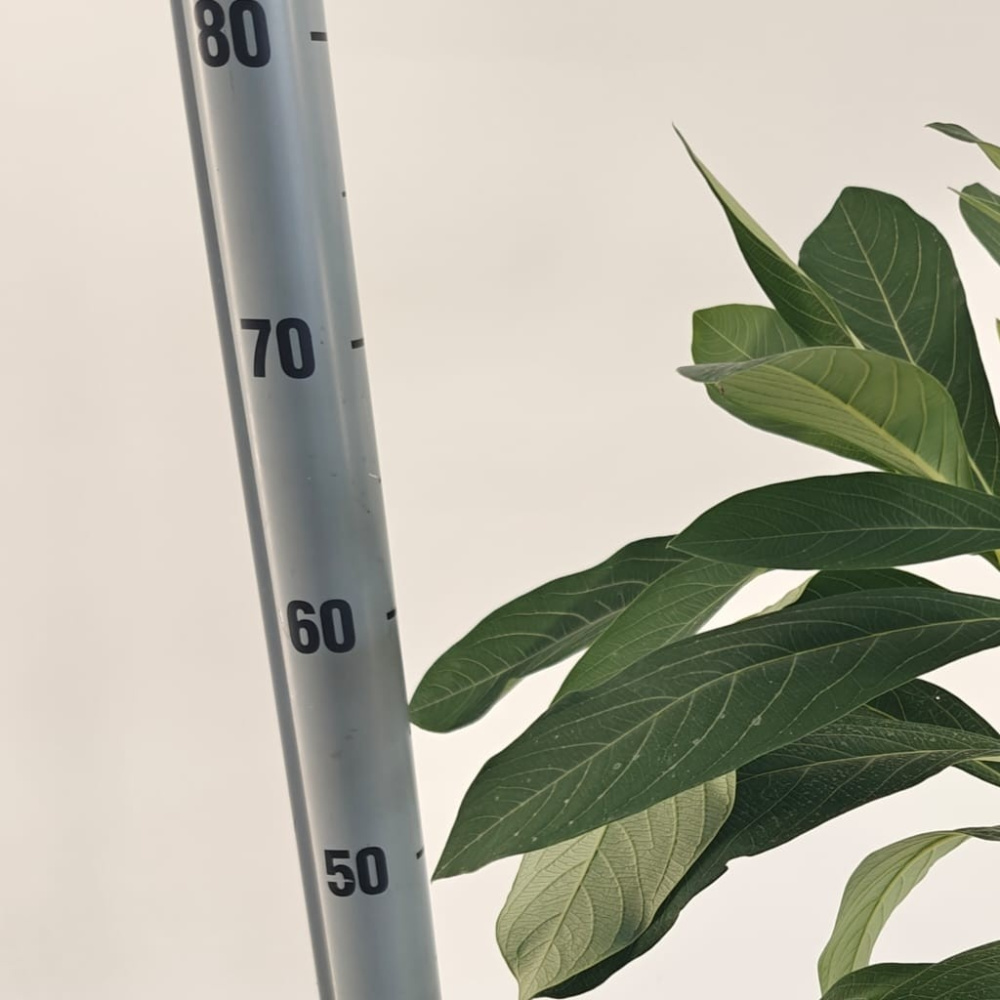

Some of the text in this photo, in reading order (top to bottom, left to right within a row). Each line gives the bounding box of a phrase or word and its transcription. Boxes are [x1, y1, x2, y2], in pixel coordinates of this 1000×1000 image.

[196, 0, 271, 68] 80
[241, 317, 316, 380] 70
[287, 598, 356, 655] 60
[324, 846, 389, 897] 50
